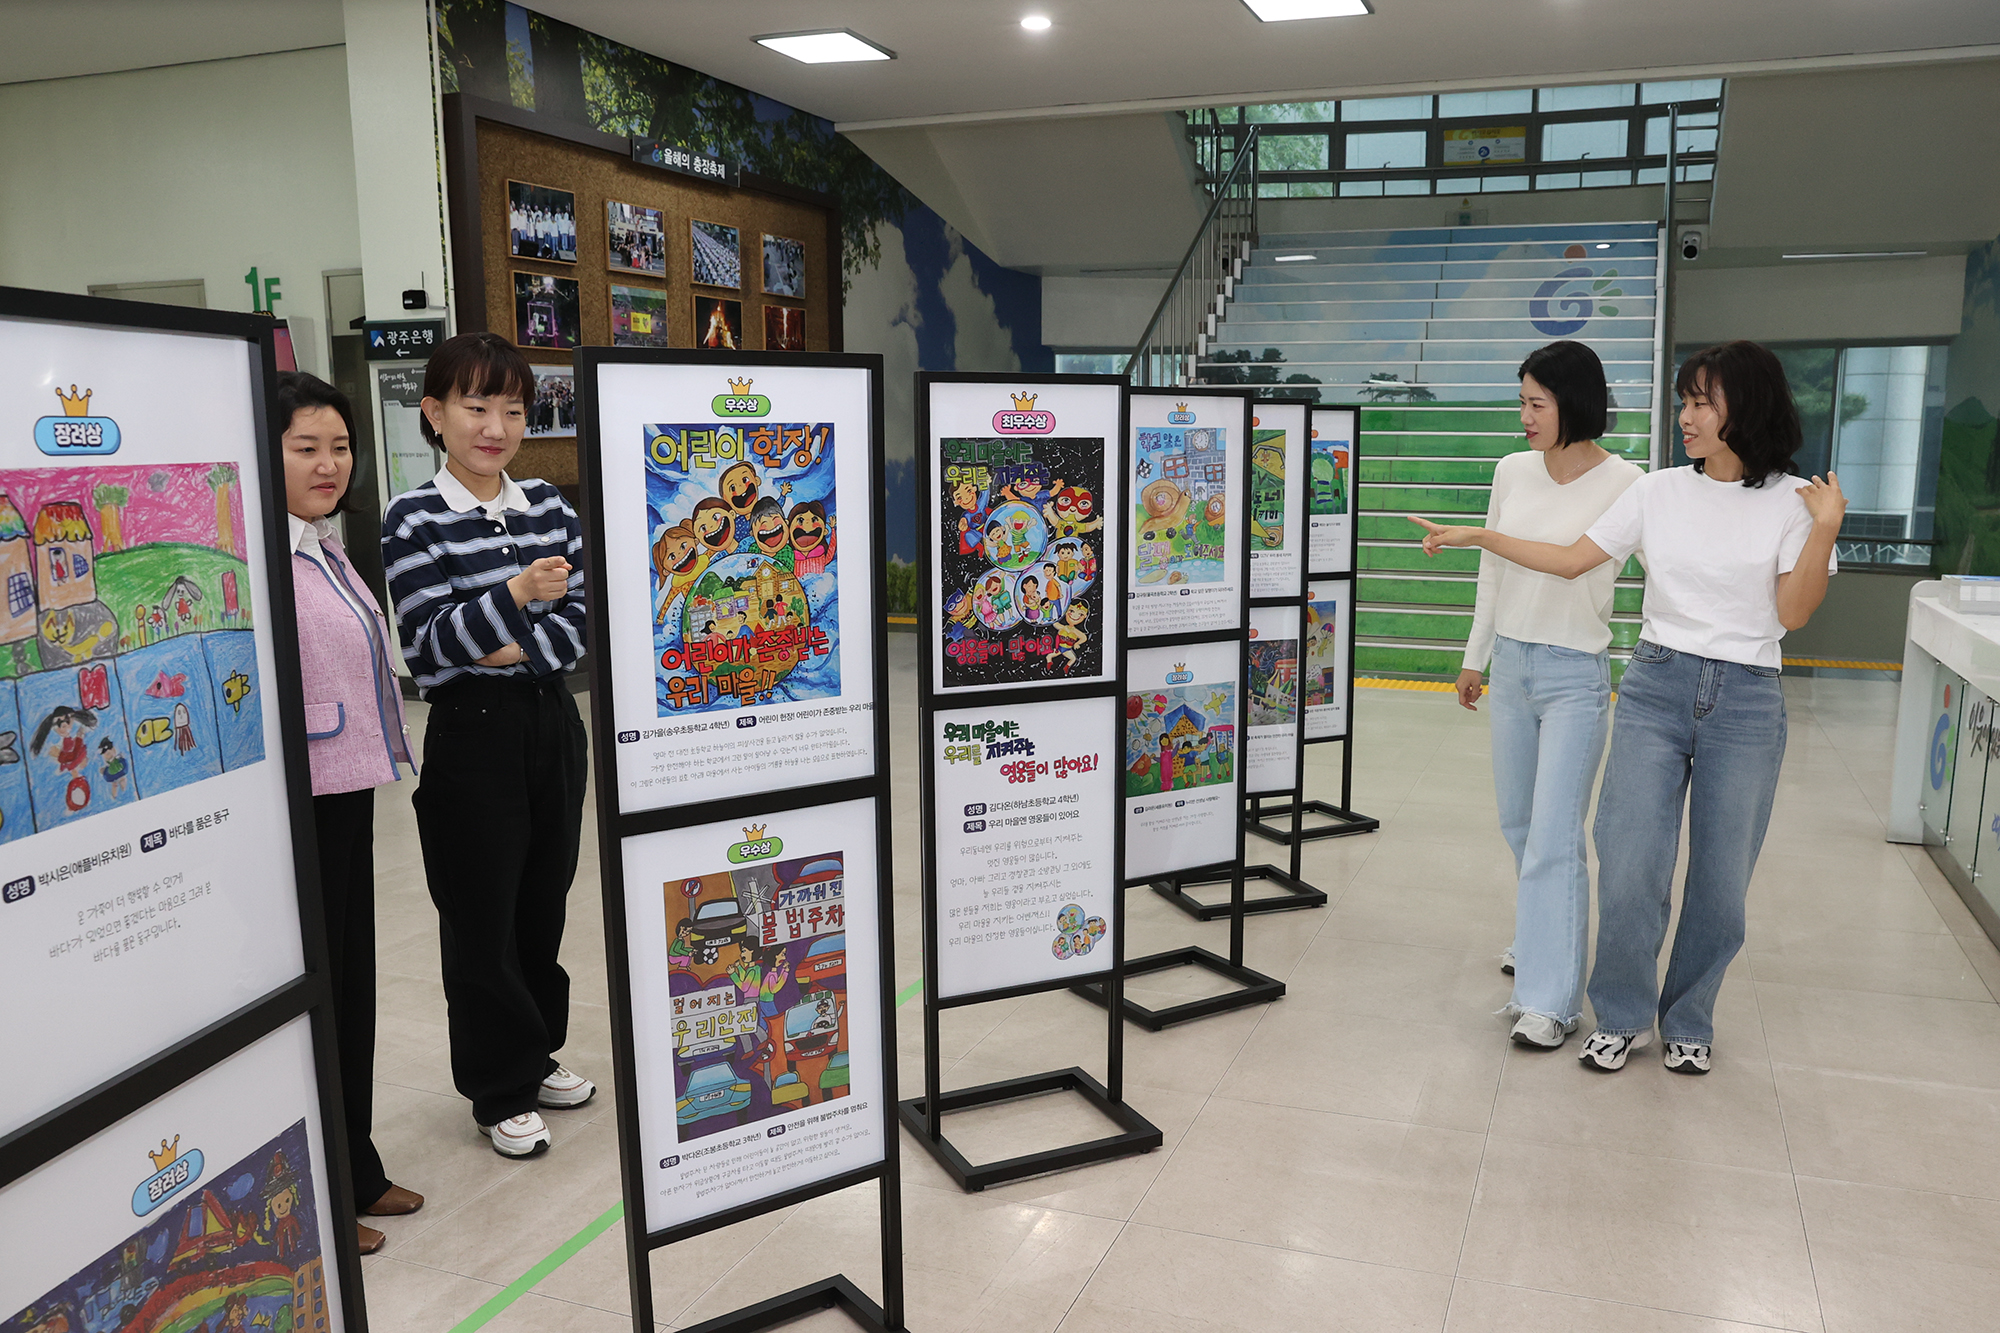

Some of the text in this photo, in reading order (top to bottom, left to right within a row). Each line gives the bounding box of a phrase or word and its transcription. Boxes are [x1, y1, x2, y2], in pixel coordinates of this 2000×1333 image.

[663, 148, 726, 180] 올해의 충장축제
[245, 266, 282, 313] 1F
[387, 329, 434, 346] 광주은행
[725, 398, 759, 413] 우수상
[1001, 413, 1048, 430] 최우수상
[53, 422, 104, 448] 장려상
[650, 424, 830, 472] 어린이 헌장!
[944, 438, 1033, 467] 우리 마을에는
[944, 465, 990, 491] 우리를
[660, 625, 830, 674] 어린이가 존중받는
[945, 633, 1060, 665] 영웅들이 많아요!
[666, 668, 775, 708] 우리 마을!!
[619, 731, 637, 742] 성명
[642, 723, 708, 740] 김가을(송우초등학교
[709, 720, 730, 731] 4학년)
[738, 717, 755, 728] 제목
[758, 713, 779, 724] 어린이
[796, 709, 822, 719] 어린이가
[823, 706, 848, 716] 존중받는
[849, 703, 862, 713] 우리
[943, 719, 1020, 744] 우리 마을에는
[943, 737, 1036, 766] 우리를 지켜주는
[999, 752, 1099, 784] 영웅들이 많아요!
[967, 793, 1080, 815] 성명 김다온(하남초등학교 4학년)
[966, 809, 1080, 832] 제목 우리 마을엔 영웅들이 있어요
[6, 808, 231, 900] 성명 박시은(애플비유치원) 제목 바다를 품은 동구
[739, 840, 772, 858] 우수상
[988, 872, 1007, 884] 그리고
[87, 901, 115, 919] 가족이
[116, 895, 126, 908] 더
[152, 882, 161, 894] 수
[162, 872, 184, 890] 있게
[49, 934, 84, 959] 바다가
[86, 919, 122, 943] 있었으면
[93, 941, 121, 962] 바다를
[137, 917, 182, 946] 동구입니다.
[761, 903, 846, 945] 불법주차
[673, 991, 735, 1015] 멀어지는
[662, 1157, 678, 1168] 성명
[742, 1132, 762, 1145] 3학년)
[787, 1118, 806, 1132] 안전을
[806, 1115, 820, 1125] 위해
[148, 1160, 189, 1203] 장려상
